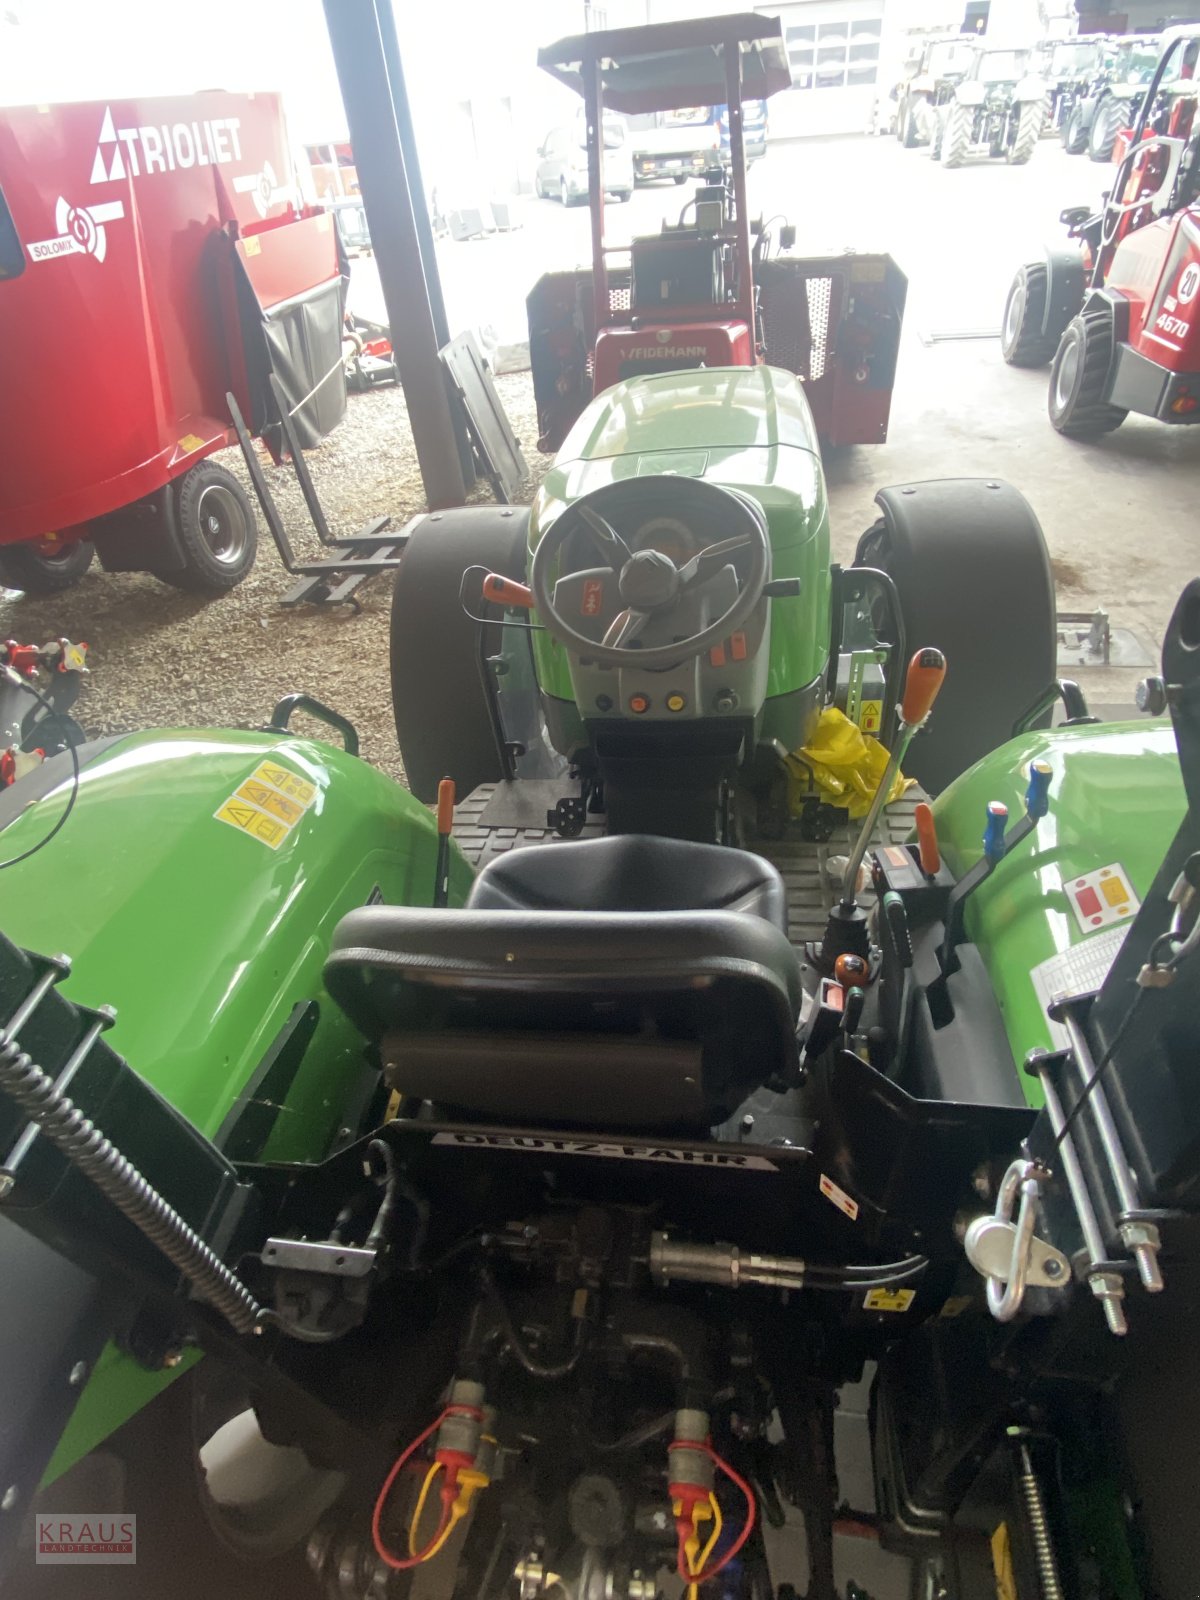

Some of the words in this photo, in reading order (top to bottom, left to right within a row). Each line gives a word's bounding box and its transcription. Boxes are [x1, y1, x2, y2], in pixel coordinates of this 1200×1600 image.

[117, 117, 242, 177] TRIOLIET
[33, 240, 73, 257] SOLOMIX
[1180, 270, 1198, 298] 20
[1156, 313, 1190, 338] 4670
